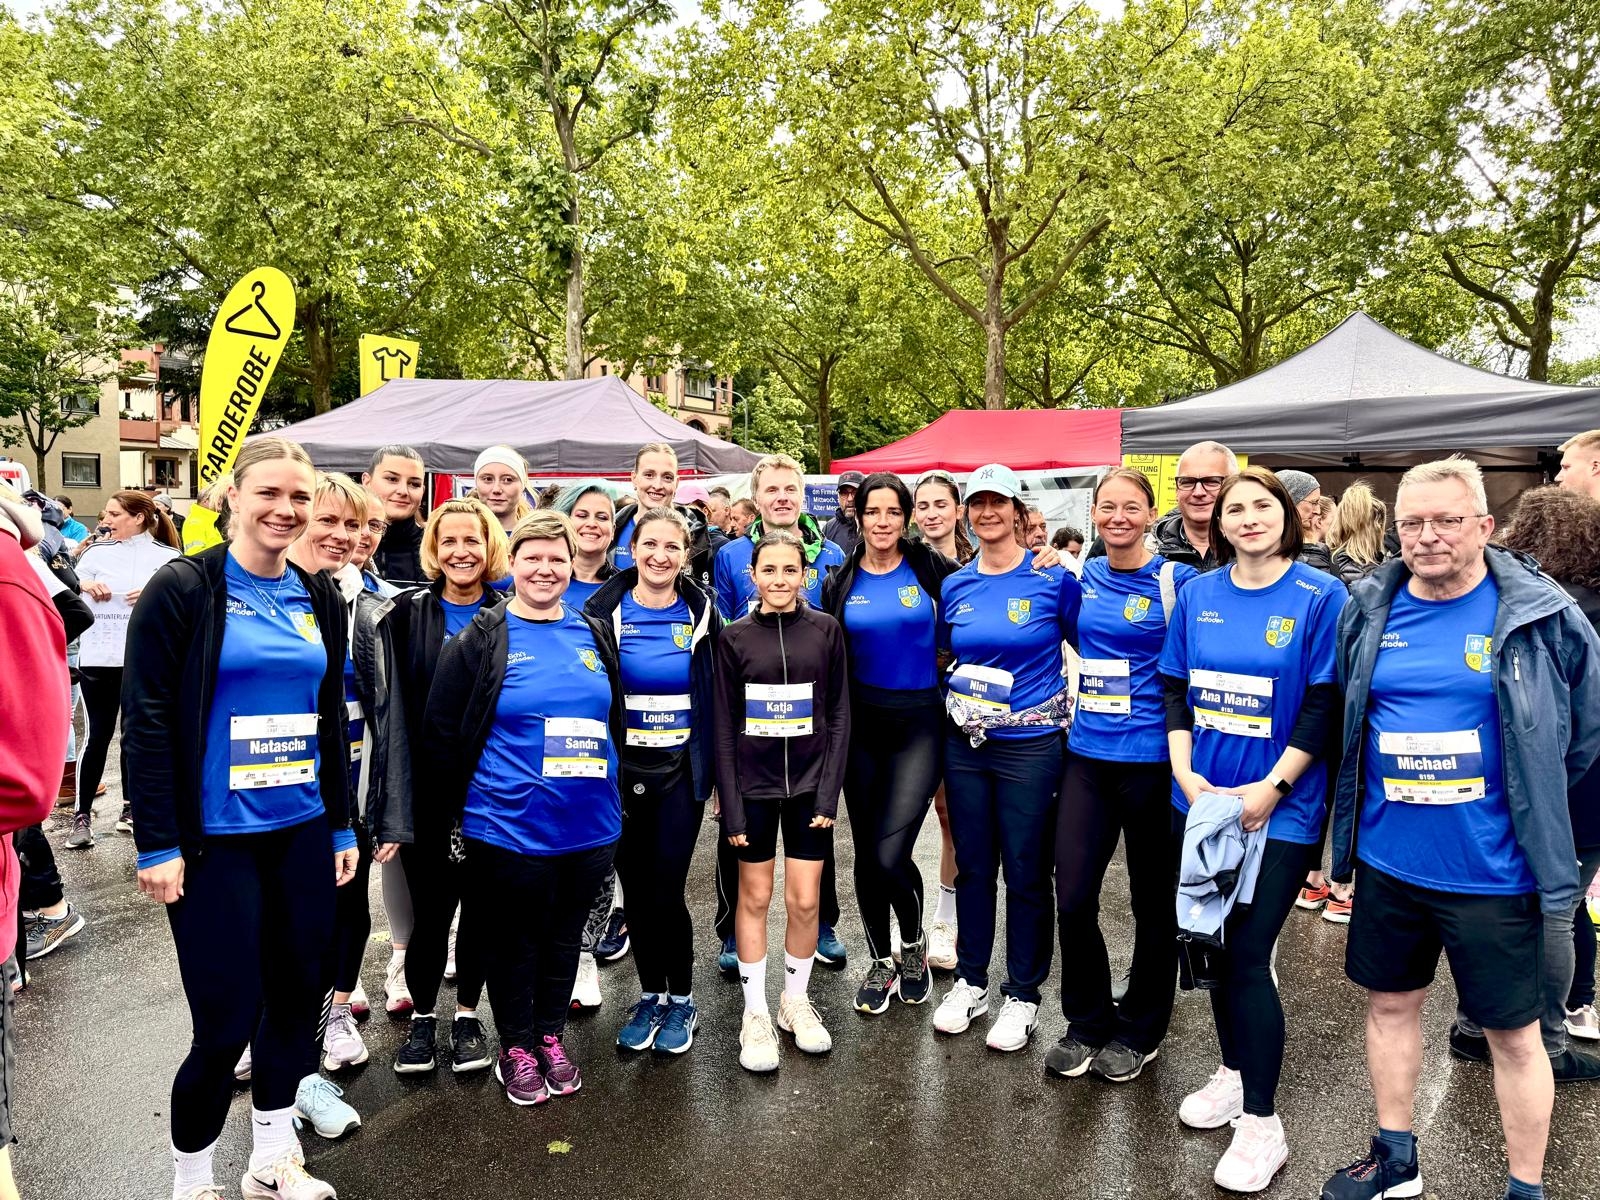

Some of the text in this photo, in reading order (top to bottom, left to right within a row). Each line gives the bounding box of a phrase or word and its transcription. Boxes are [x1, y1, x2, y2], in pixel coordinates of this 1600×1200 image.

[200, 344, 271, 483] GARDEROBE
[226, 607, 256, 616] ufladen
[1382, 632, 1400, 640] ichi's
[970, 679, 988, 693] Nini
[1083, 676, 1104, 688] Julia
[1200, 689, 1259, 708] Ana Maria
[767, 702, 793, 714] Katja
[643, 712, 675, 724] Louisa
[250, 738, 307, 755] Natascha
[565, 737, 599, 751] Sandra
[1397, 756, 1458, 771] Michael
